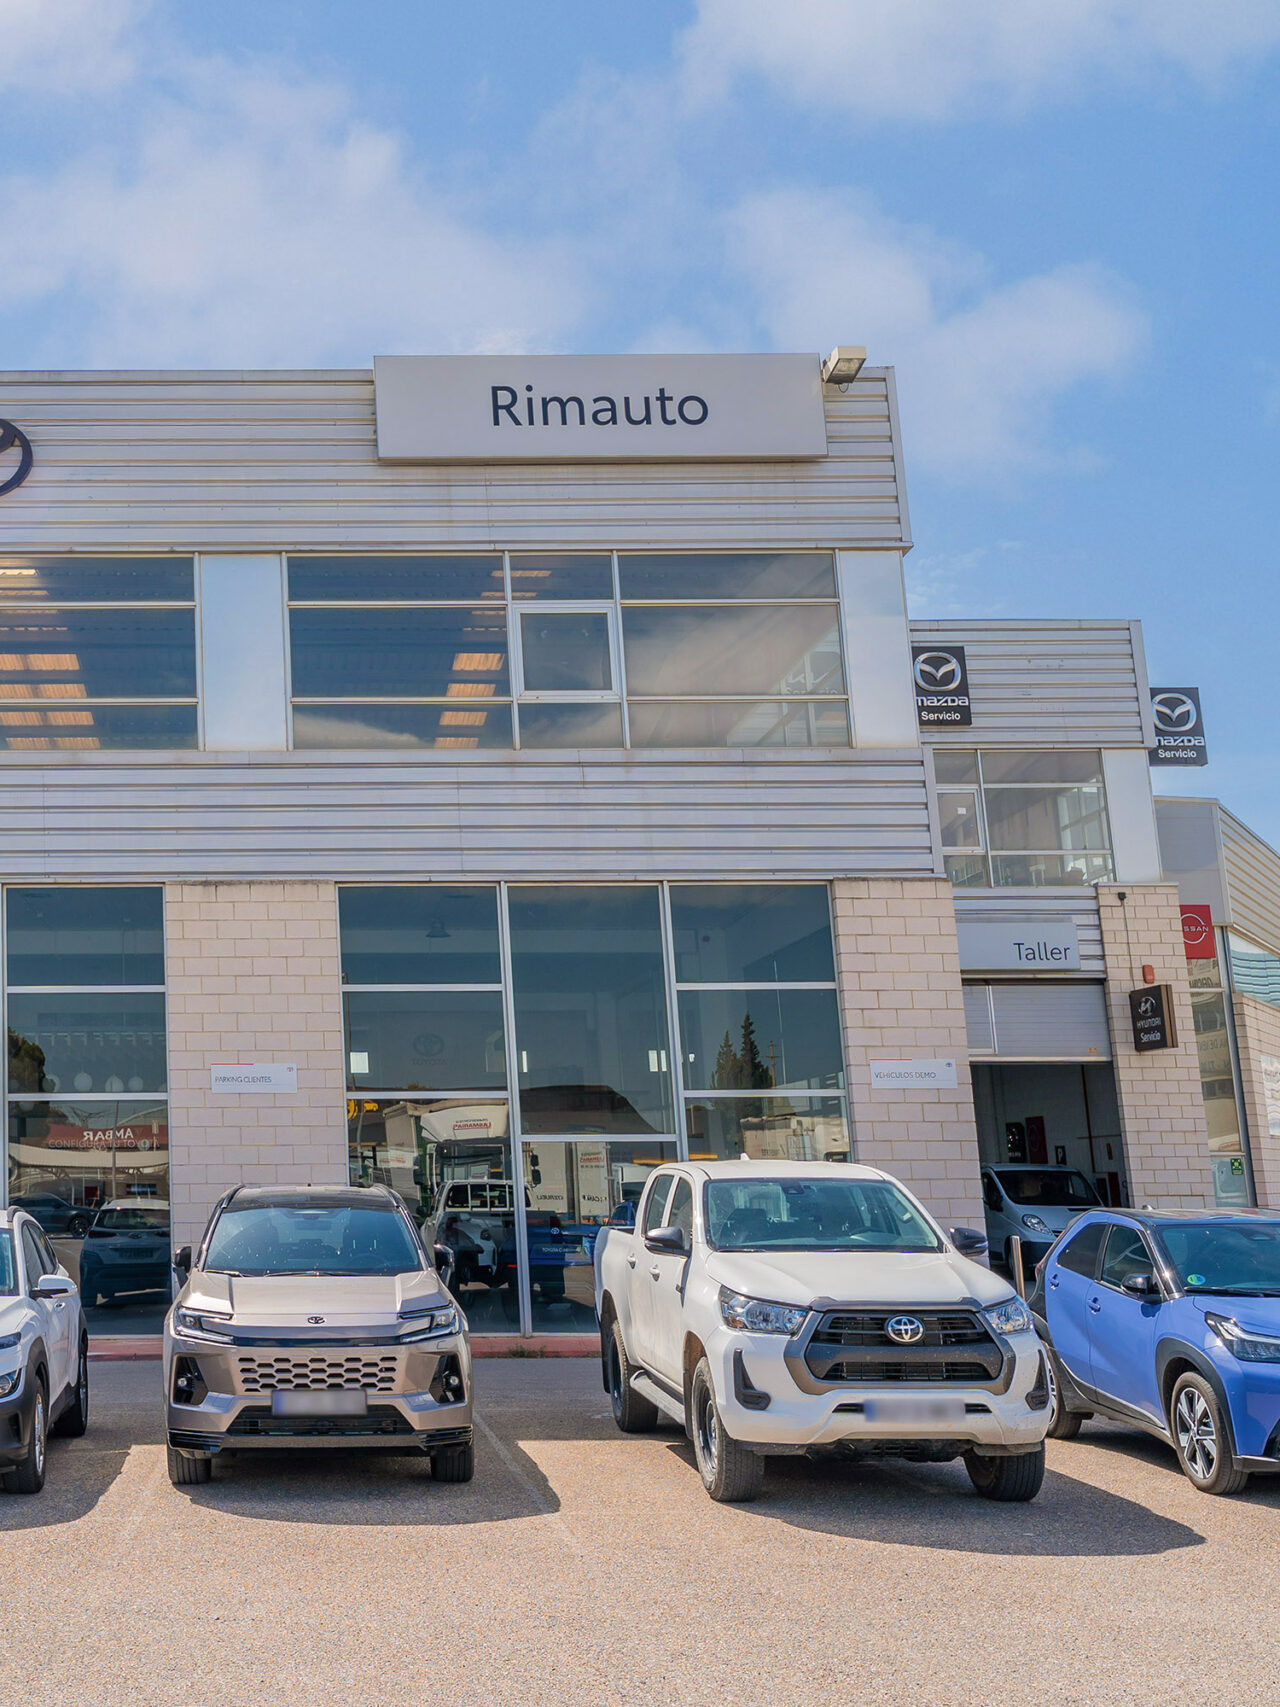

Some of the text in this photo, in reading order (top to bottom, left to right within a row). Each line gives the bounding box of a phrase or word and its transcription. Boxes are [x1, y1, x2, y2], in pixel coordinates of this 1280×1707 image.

[491, 385, 710, 427] Rimauto
[921, 711, 961, 720] Servicio
[1158, 749, 1197, 758] Servicio
[1013, 942, 1071, 961] Taller
[1136, 1017, 1161, 1029] HYUNDAI
[1140, 1031, 1161, 1042] Servicio
[215, 1076, 272, 1084] PARKING CLIENTES
